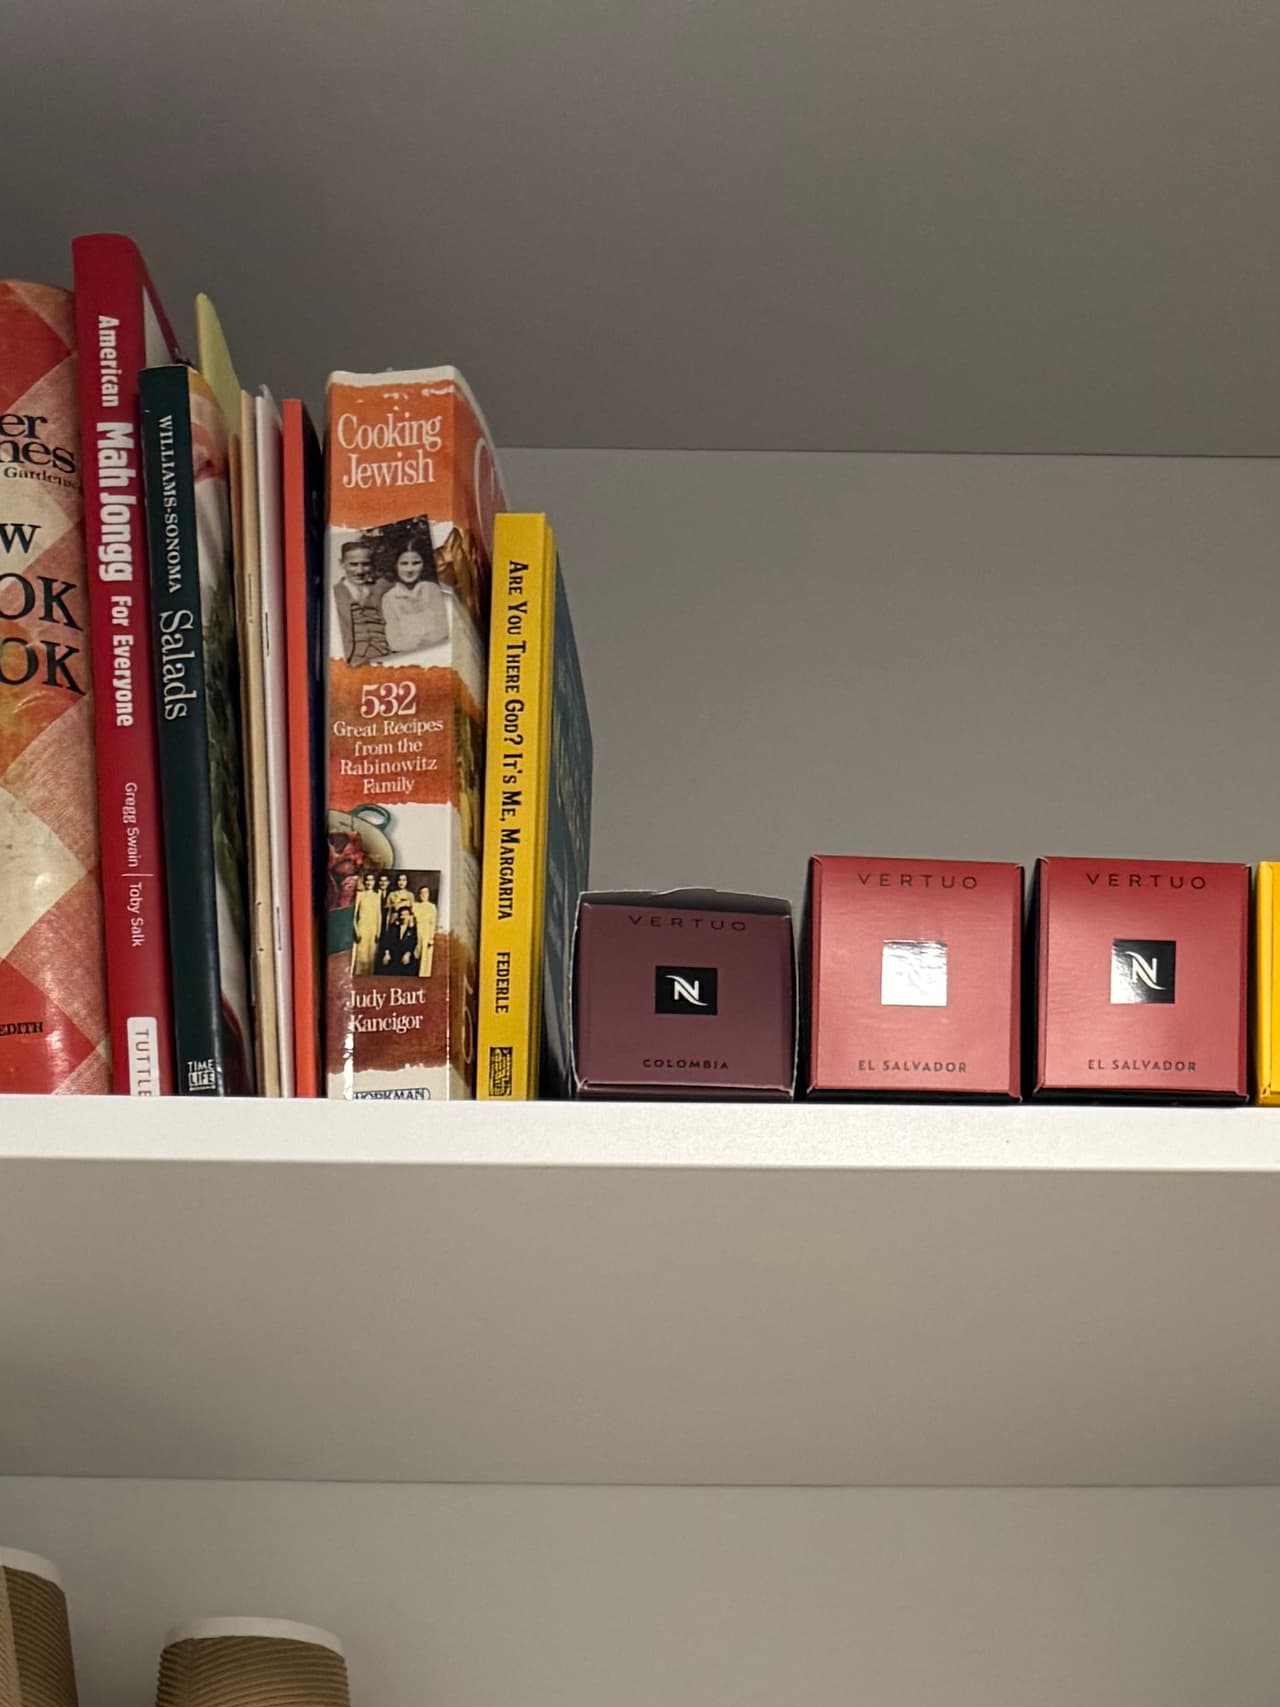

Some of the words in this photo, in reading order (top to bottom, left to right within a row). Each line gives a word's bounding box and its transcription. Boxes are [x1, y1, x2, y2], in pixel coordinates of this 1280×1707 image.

[97, 315, 120, 408] American
[337, 413, 443, 453] Cooking
[96, 421, 137, 487] Mah
[341, 453, 436, 488] Jewish
[159, 414, 180, 594] WILLIAMS-SONOMA
[97, 489, 135, 583] Jongg
[111, 596, 133, 626] For
[160, 609, 198, 720] Salads
[112, 635, 135, 727] Everyone
[360, 681, 417, 719] 532
[333, 721, 377, 738] Great
[383, 719, 445, 736] Recipes
[354, 741, 393, 757] from
[398, 738, 423, 753] the
[340, 756, 438, 776] Rabinowitz
[363, 776, 415, 795] Family
[121, 782, 137, 823] Gregg
[125, 827, 139, 869] Swain
[858, 872, 978, 890] VERTUO
[1086, 873, 1208, 891] VERTUO
[128, 881, 143, 914] Toby
[131, 918, 145, 948] Salk
[628, 915, 748, 932] VERTUO
[495, 952, 511, 1014] FEDERLE
[346, 989, 387, 1011] Judy
[389, 987, 426, 1006] Bart
[351, 1013, 424, 1034] Kancigor
[188, 1059, 214, 1073] TIME
[189, 1072, 215, 1087] LIFE
[641, 1058, 730, 1071] COLOMBIA
[857, 1060, 879, 1072] EL
[881, 1060, 968, 1073] SALVADOR
[1087, 1059, 1108, 1071] EL
[1111, 1060, 1197, 1074] SALVADOR
